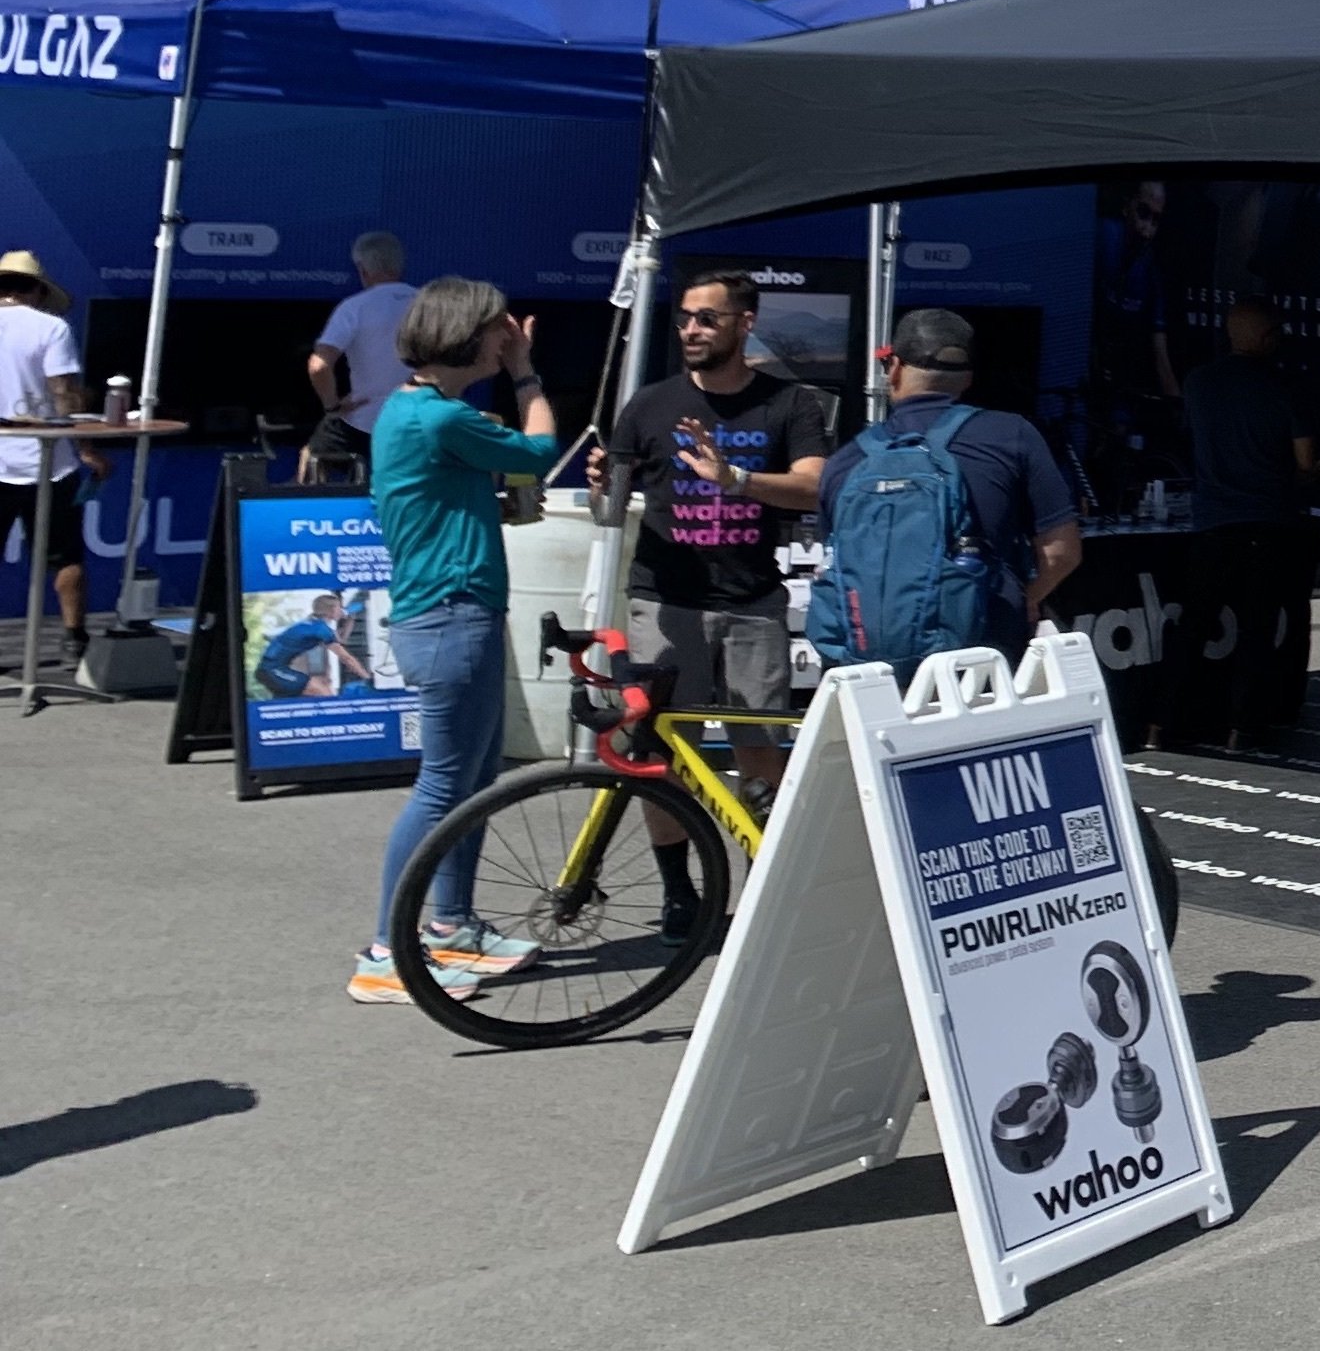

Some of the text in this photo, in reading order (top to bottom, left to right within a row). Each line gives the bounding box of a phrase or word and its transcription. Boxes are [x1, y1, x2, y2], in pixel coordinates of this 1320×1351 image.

[0, 13, 124, 80] ULGAZ
[206, 231, 254, 247] TRAIN
[585, 239, 626, 255] EXPLO
[671, 423, 768, 447] whoo
[290, 519, 383, 536] FULGA
[263, 551, 333, 576] WIN
[680, 764, 752, 852] CANYO
[958, 751, 1051, 824] WIN
[919, 824, 1052, 878] SCAN THIS CODE TO
[924, 848, 1068, 907] ENTER THE GIVEAWAY
[1032, 1146, 1164, 1221] wahoo
